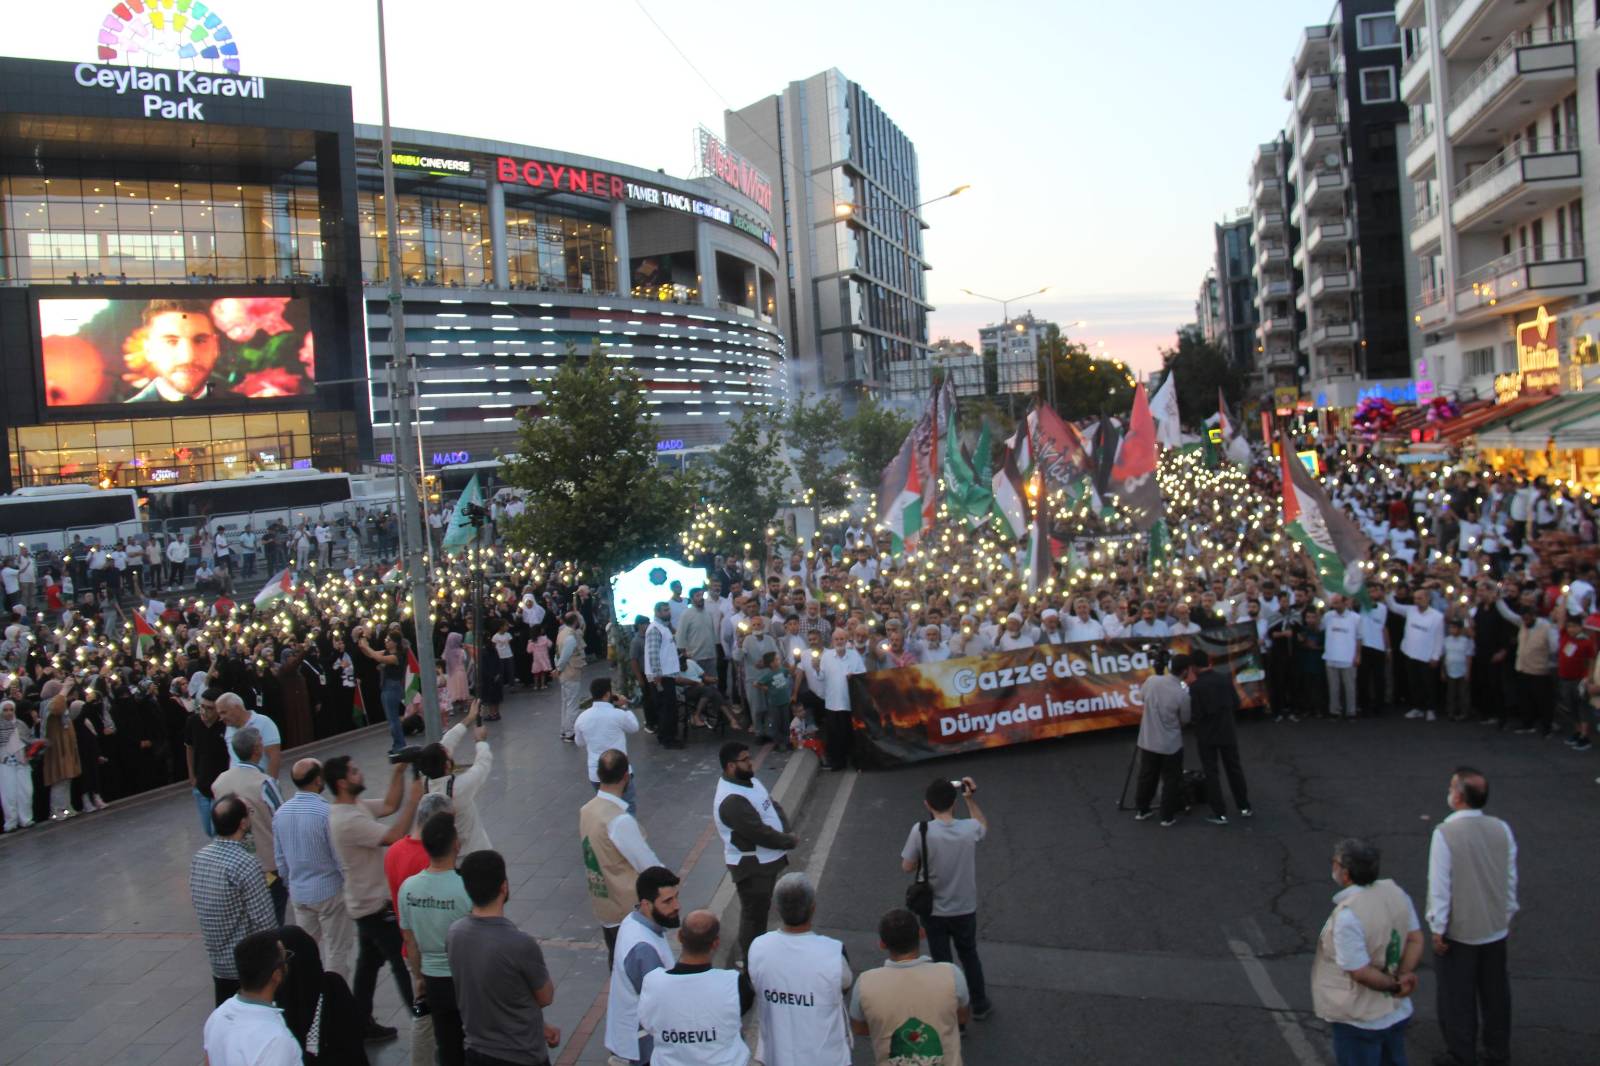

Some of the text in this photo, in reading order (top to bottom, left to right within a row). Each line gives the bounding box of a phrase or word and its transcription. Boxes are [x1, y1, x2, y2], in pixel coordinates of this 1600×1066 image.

[74, 63, 265, 99] Ceylan Karavil
[143, 95, 204, 121] Park
[420, 157, 470, 172] CINEVERSE
[496, 156, 625, 200] BOYNER
[627, 183, 691, 213] TAMER TANCA
[657, 439, 684, 450] MADO
[432, 451, 469, 465] MADO
[953, 644, 1154, 693] Gazze'de İnsa
[940, 702, 1044, 736] Dünyada
[1046, 691, 1129, 717] İnsanlık
[763, 988, 815, 1007] GÖREVLİ
[661, 1026, 717, 1044] GÖREVLİ
